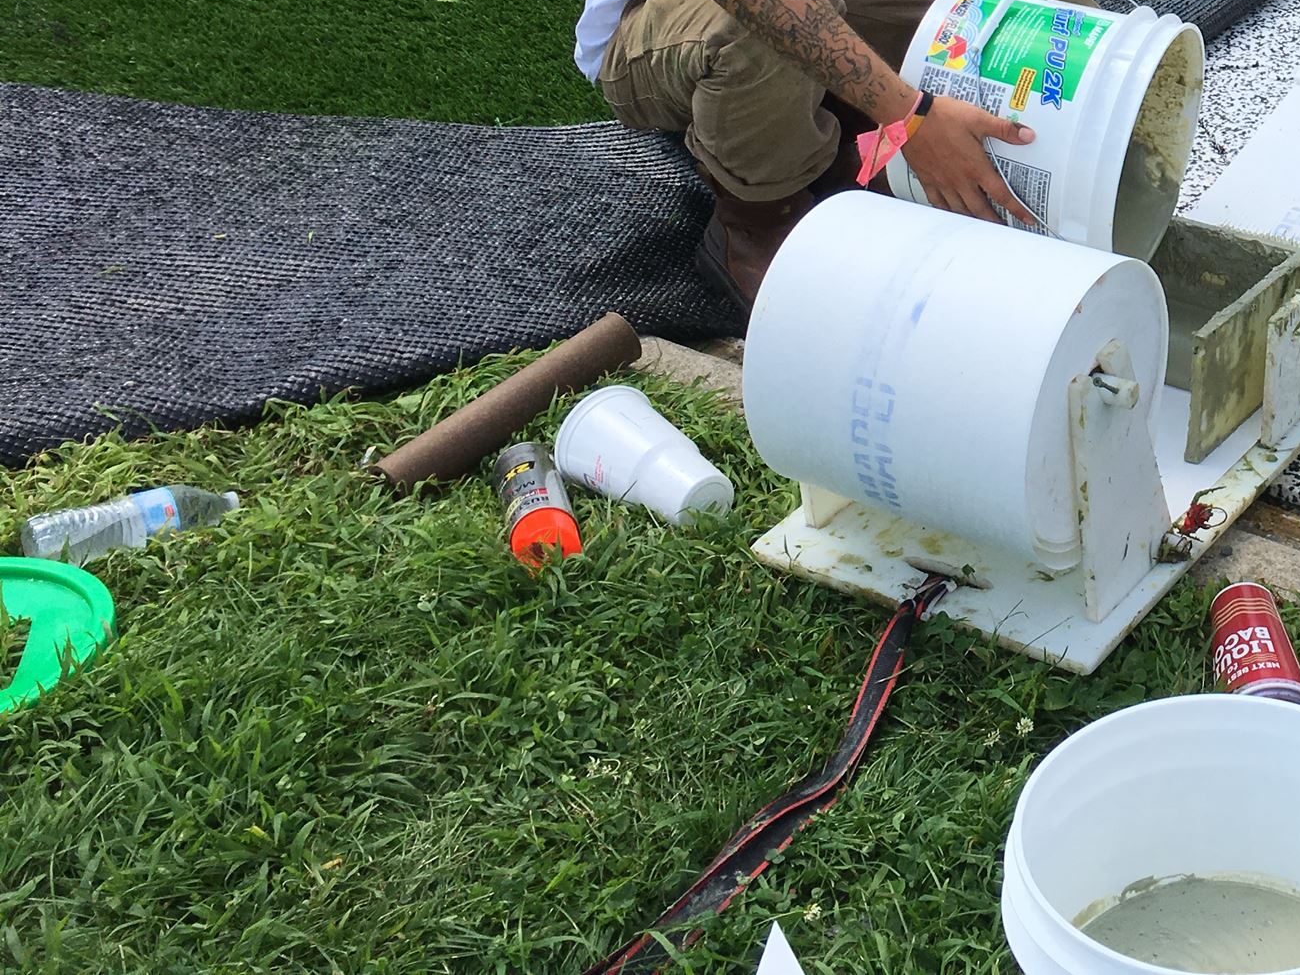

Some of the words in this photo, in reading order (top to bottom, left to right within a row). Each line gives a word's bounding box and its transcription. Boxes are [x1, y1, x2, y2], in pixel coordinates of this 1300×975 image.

[1052, 8, 1074, 36] Turf
[1046, 35, 1069, 70] PU
[1041, 68, 1064, 110] 2K
[1214, 626, 1272, 664] BACO
[1226, 666, 1249, 685] BEST
[1227, 662, 1239, 674] to
[1251, 661, 1281, 671] NEXT
